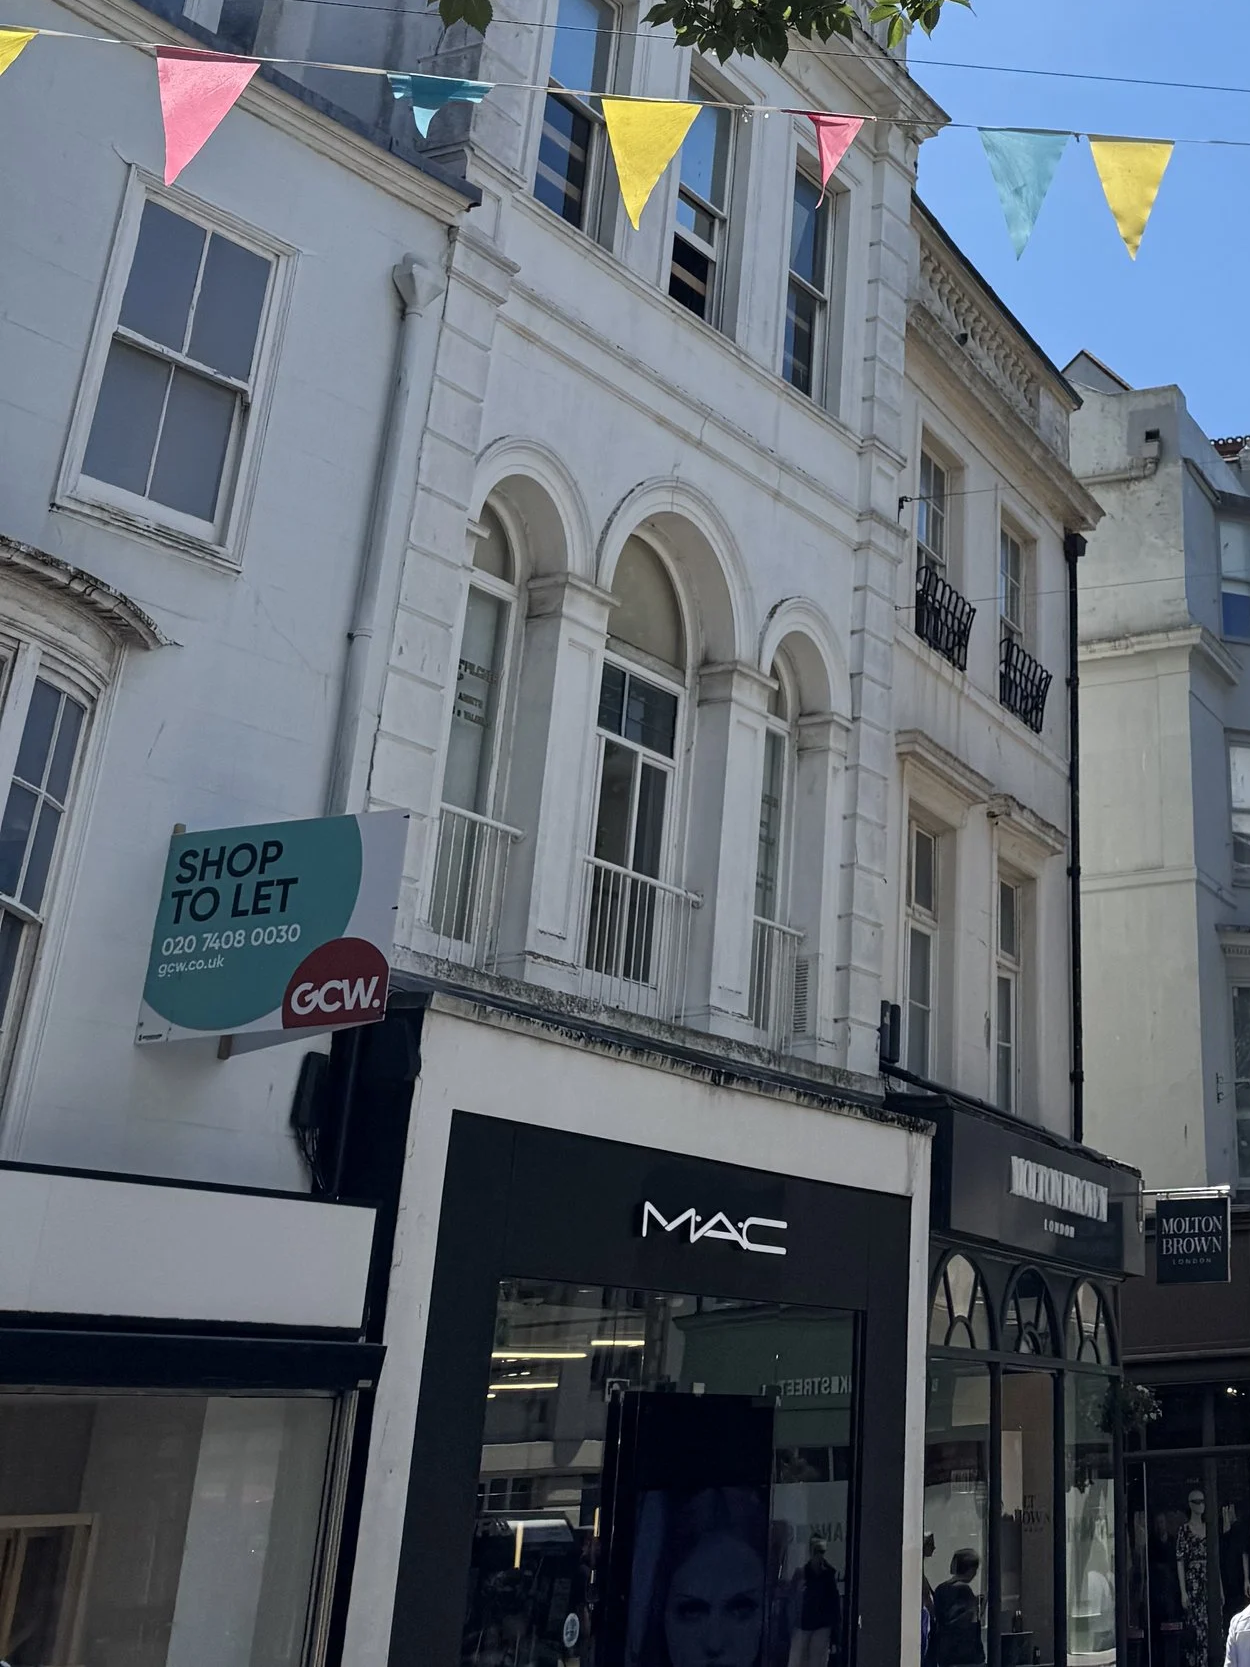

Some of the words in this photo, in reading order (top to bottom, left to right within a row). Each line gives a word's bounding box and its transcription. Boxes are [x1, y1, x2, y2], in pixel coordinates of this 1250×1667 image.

[175, 840, 283, 884] SHOP
[171, 886, 220, 924] TO
[231, 877, 298, 918] LET
[161, 935, 197, 956] 020
[202, 929, 246, 952] 7408
[250, 924, 301, 946] 0030
[157, 955, 225, 978] gcw.co.uk
[1161, 1215, 1223, 1235] MOLTON
[1162, 1235, 1222, 1255] BROWN
[1172, 1257, 1212, 1265] LONDON
